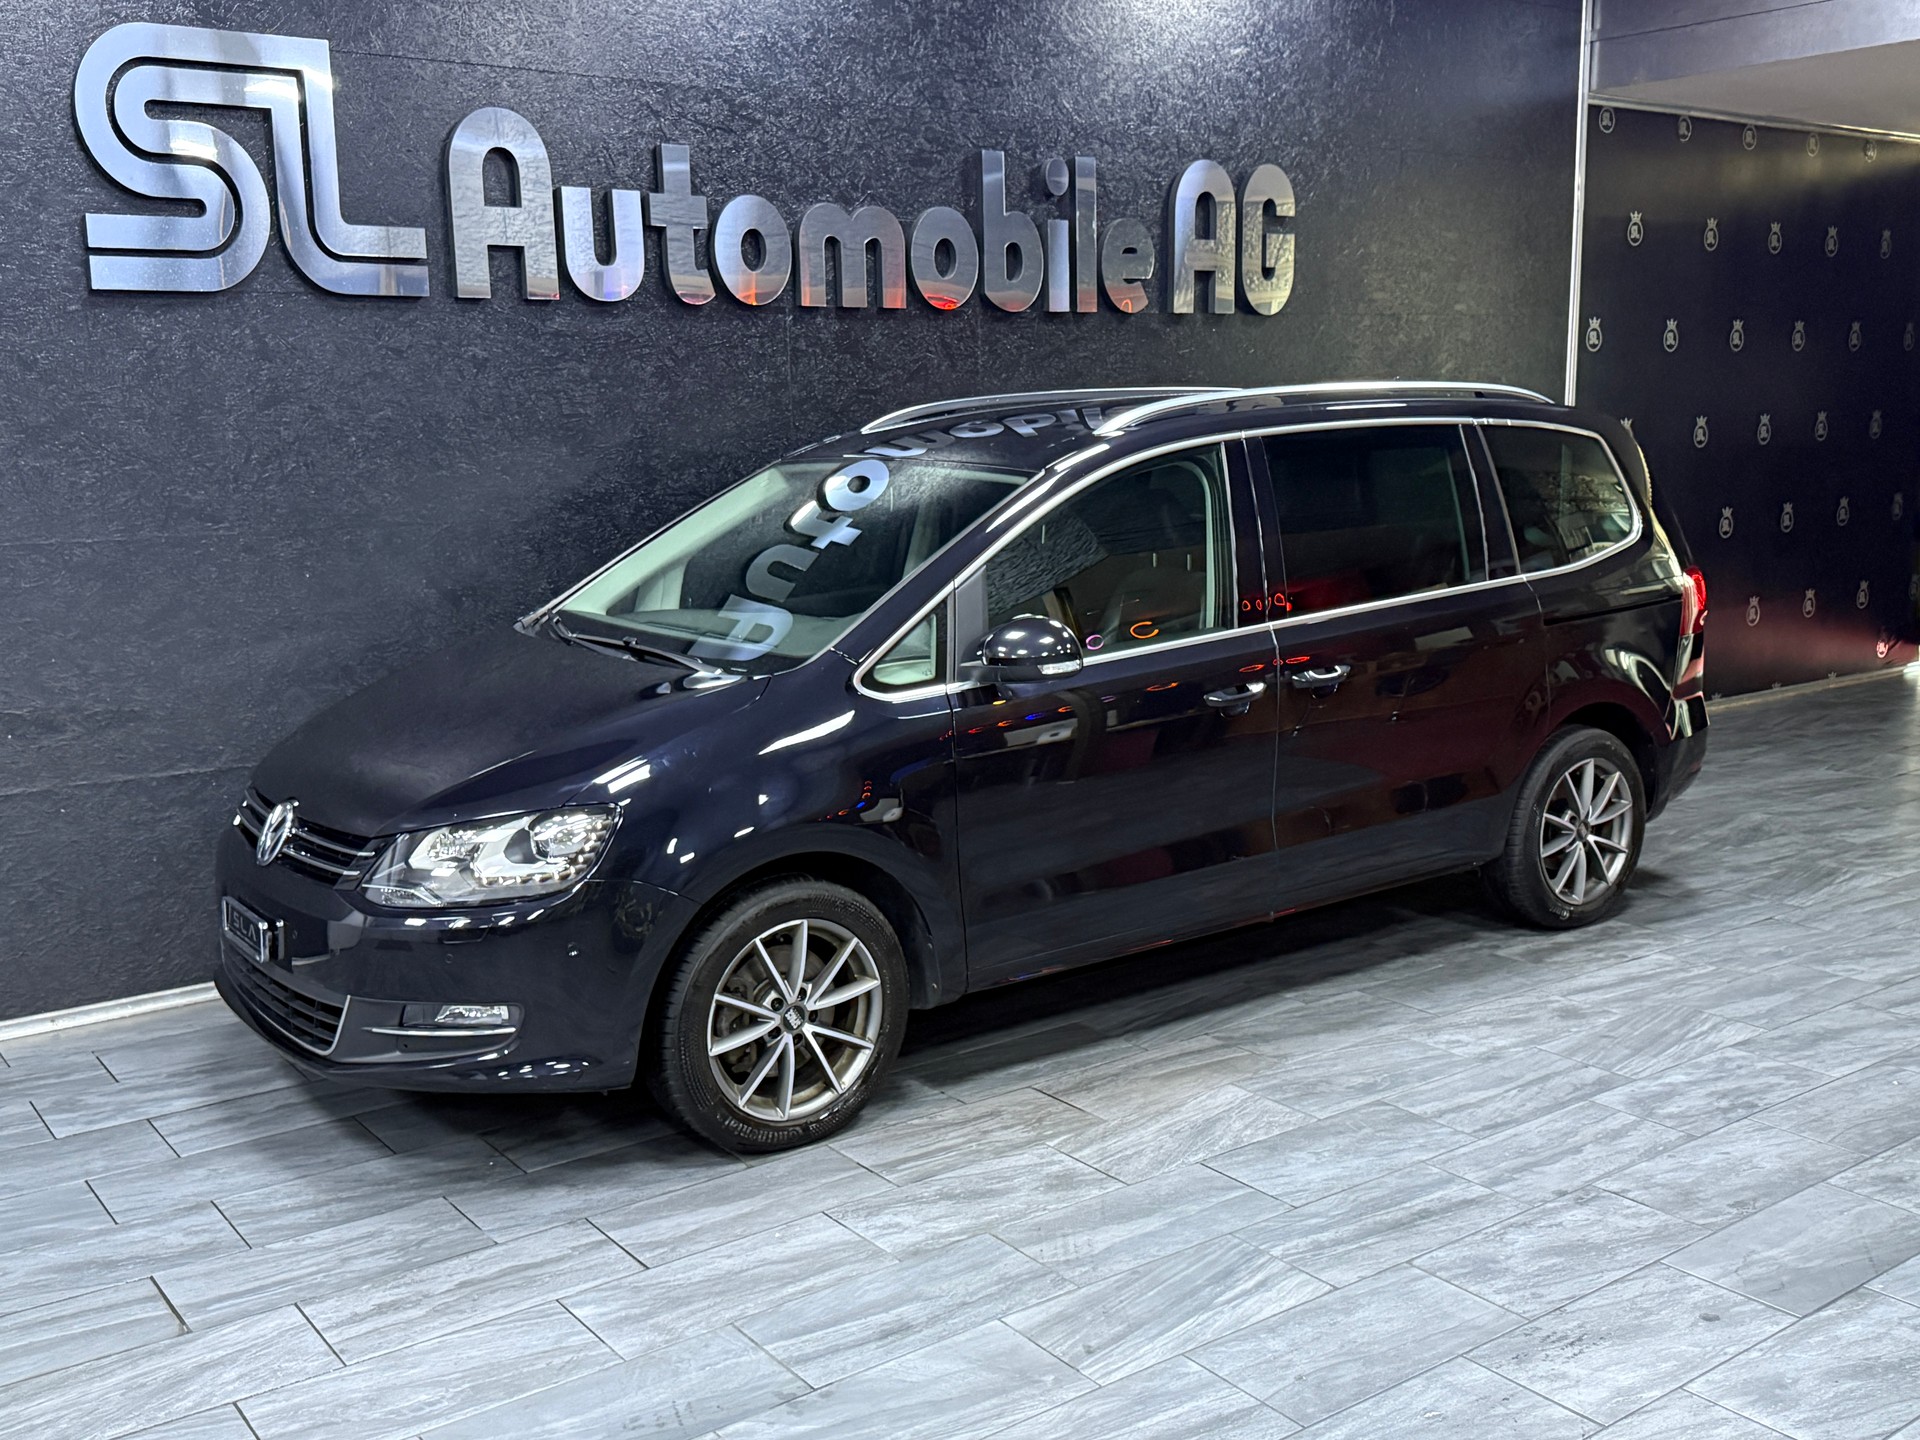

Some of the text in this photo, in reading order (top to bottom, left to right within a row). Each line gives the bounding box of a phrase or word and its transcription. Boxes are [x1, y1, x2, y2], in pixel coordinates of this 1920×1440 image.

[74, 22, 1297, 316] SL Automobile AG
